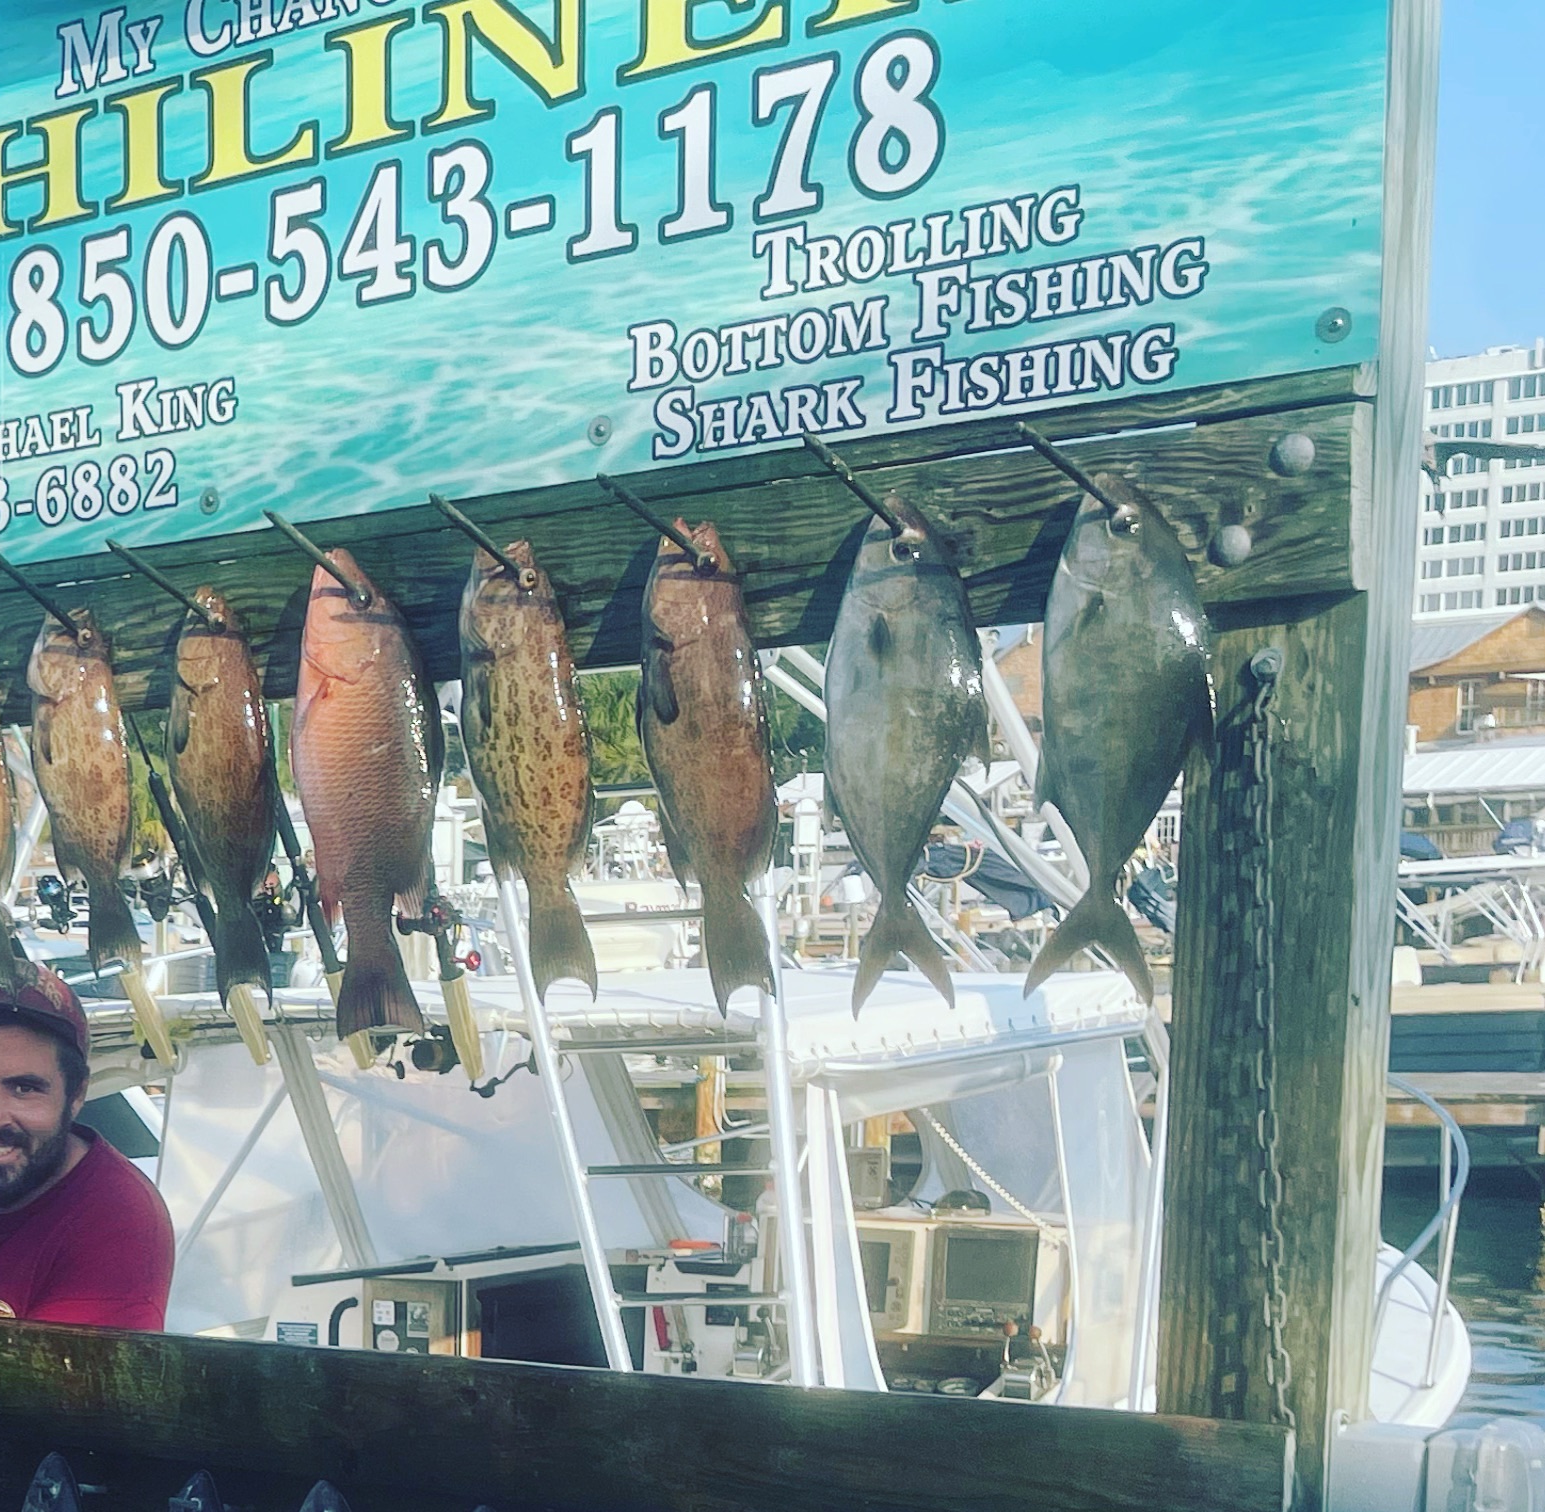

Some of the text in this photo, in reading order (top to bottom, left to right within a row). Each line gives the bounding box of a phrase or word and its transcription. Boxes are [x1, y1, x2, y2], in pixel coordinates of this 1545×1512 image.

[6, 27, 947, 378] 850-543-1178
[753, 184, 1084, 301] TROLLING
[628, 236, 1208, 393] BOTTOM FISHING
[115, 378, 237, 441] KING
[653, 323, 1177, 460] SHARK FISHING
